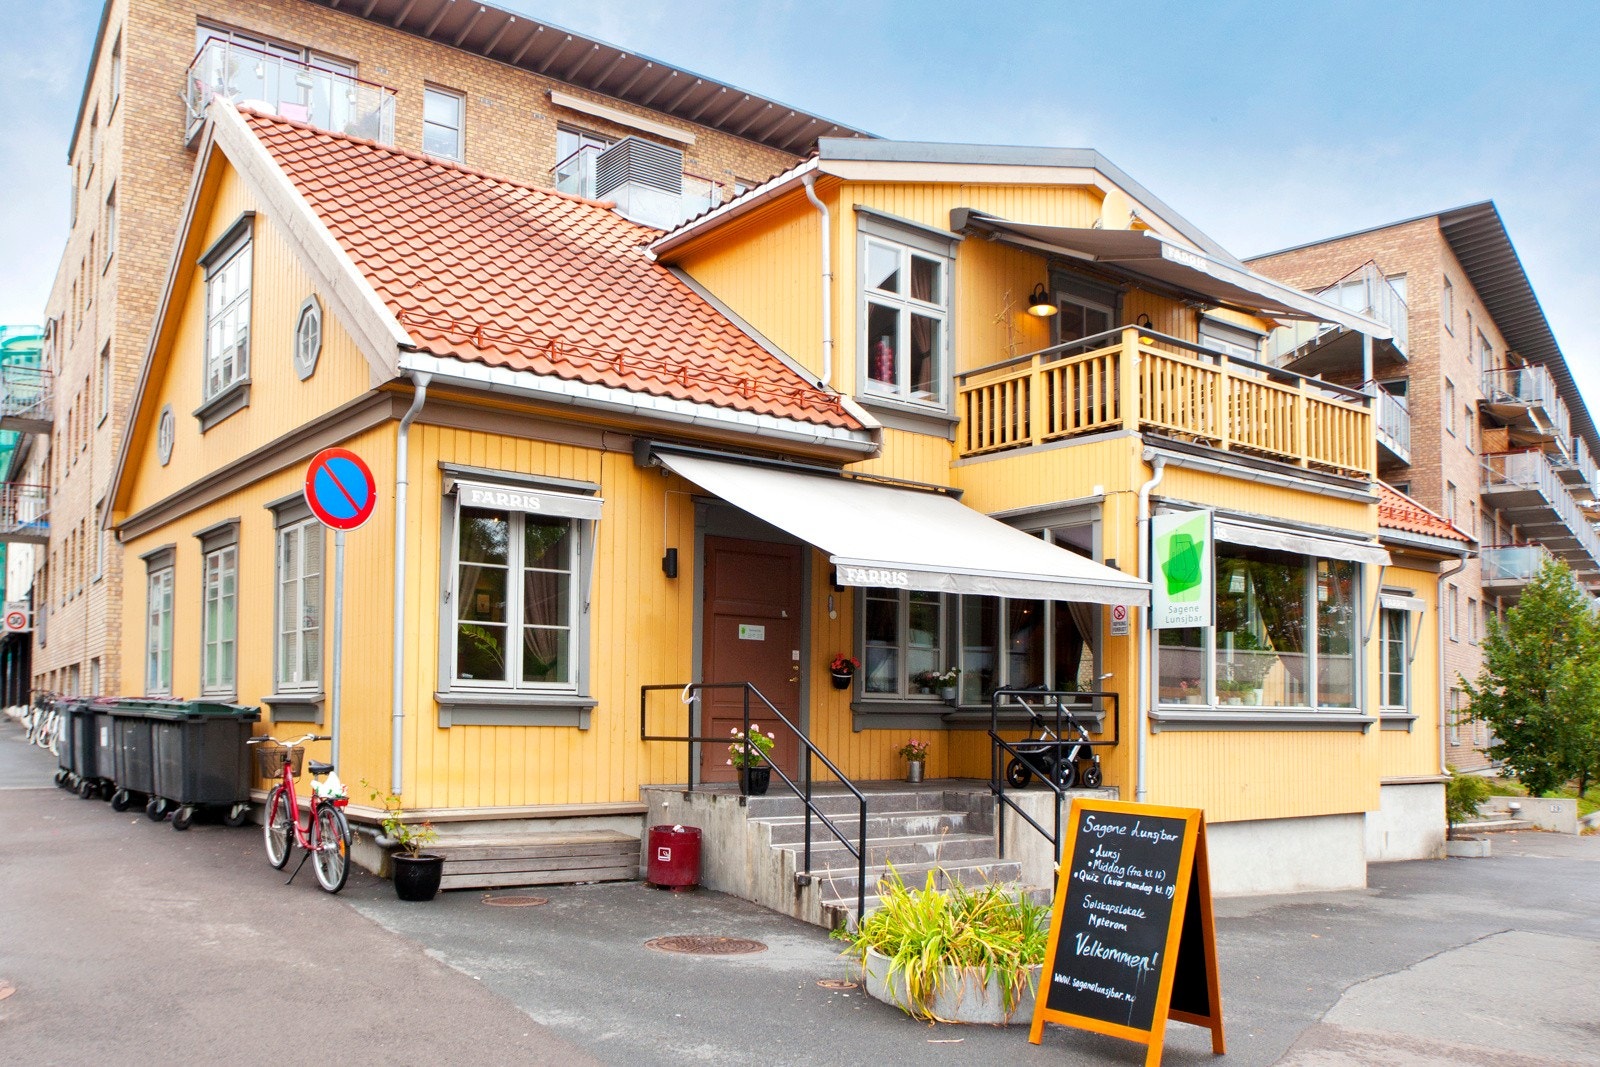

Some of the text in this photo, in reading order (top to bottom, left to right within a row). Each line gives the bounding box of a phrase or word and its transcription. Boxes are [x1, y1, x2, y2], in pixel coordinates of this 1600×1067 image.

[471, 489, 541, 510] FARRIS
[846, 567, 909, 586] FARRIS
[1165, 614, 1202, 624] Lunsjbar
[1168, 605, 1200, 615] Sagene
[1083, 815, 1178, 844] Sagene Lunsjbar
[1095, 844, 1122, 863] Lunsj
[1093, 859, 1125, 878] Middag
[1126, 865, 1143, 877] (fra
[1154, 869, 1166, 881] 16)
[1079, 869, 1099, 883] Quiz
[1125, 882, 1153, 895] mandag
[1088, 913, 1128, 931] Møterom
[1075, 932, 1159, 971] Velkommen!
